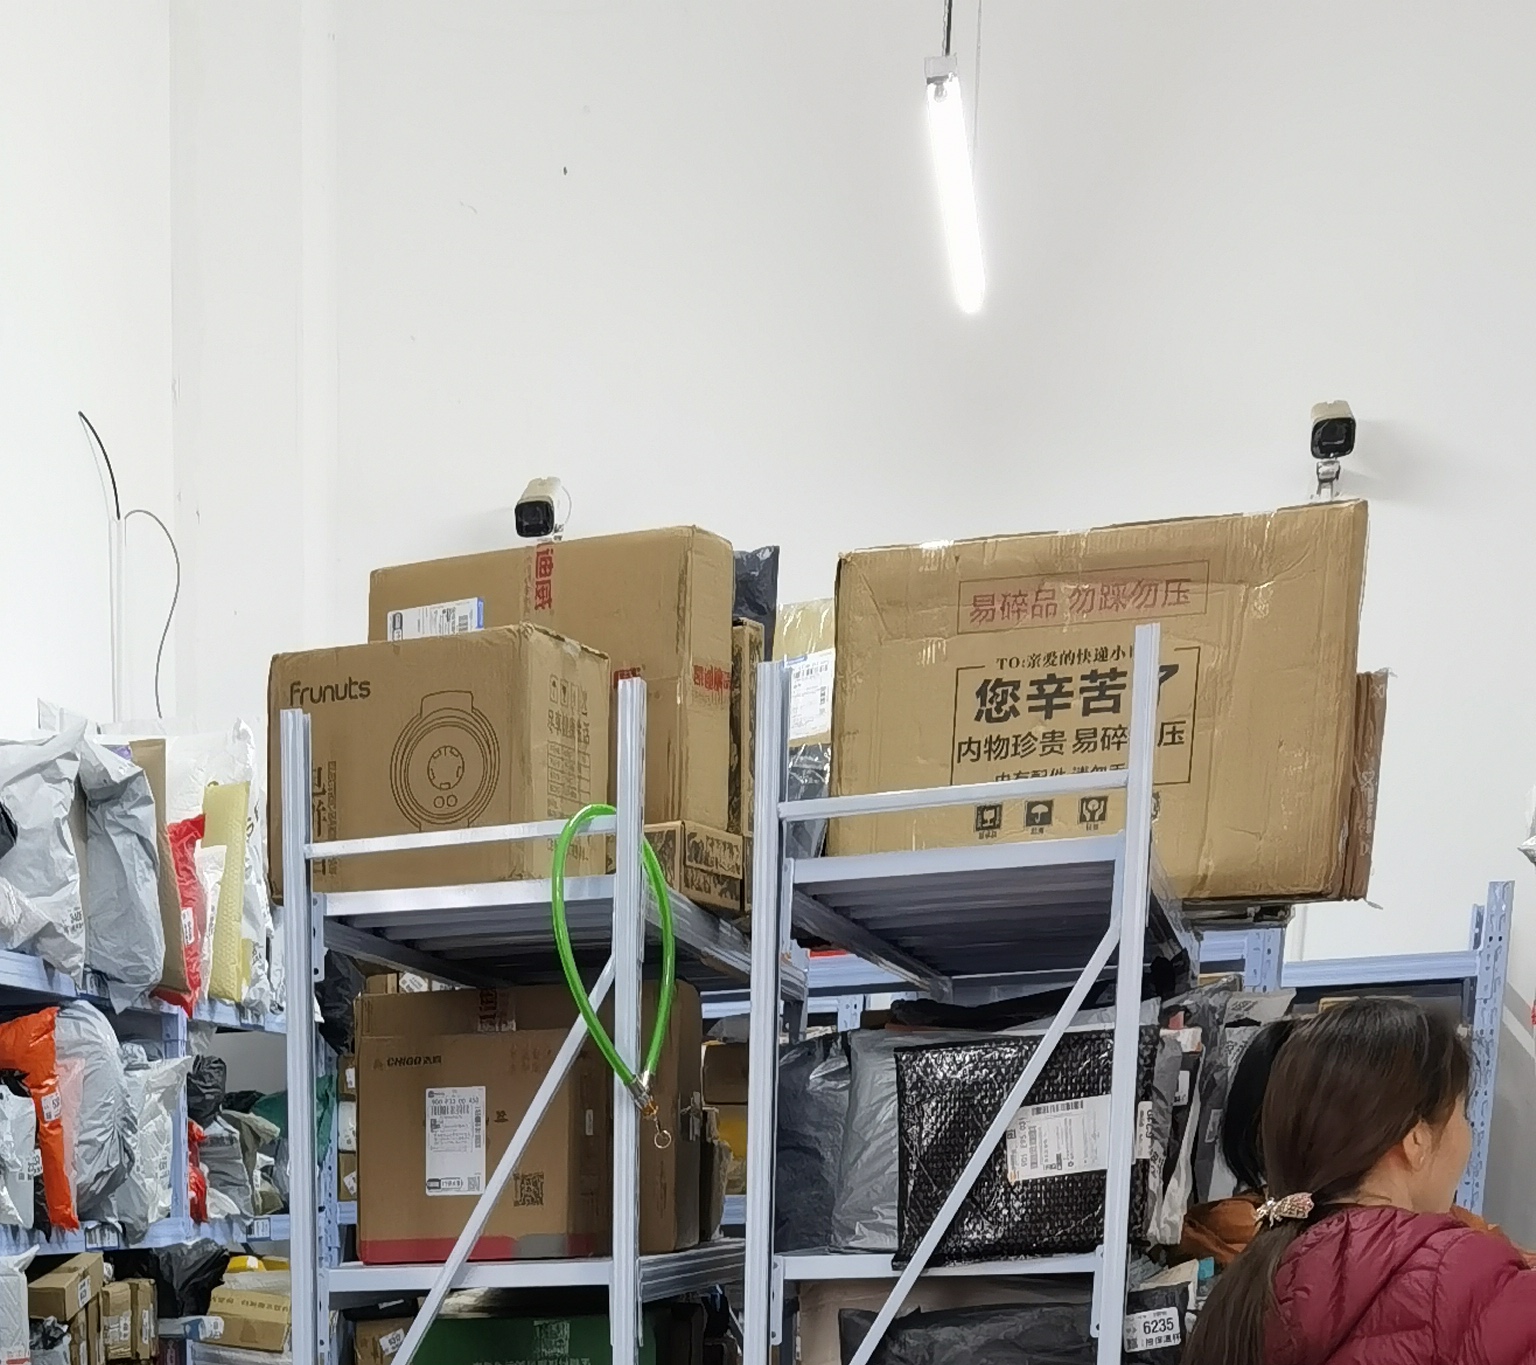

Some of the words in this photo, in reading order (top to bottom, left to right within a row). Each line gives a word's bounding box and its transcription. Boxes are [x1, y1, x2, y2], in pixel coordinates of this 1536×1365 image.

[970, 588, 1057, 626] 易碎品
[956, 729, 1065, 764] 内物珍贵
[1072, 720, 1187, 755] 易碎压
[1144, 1318, 1174, 1335] 6235
